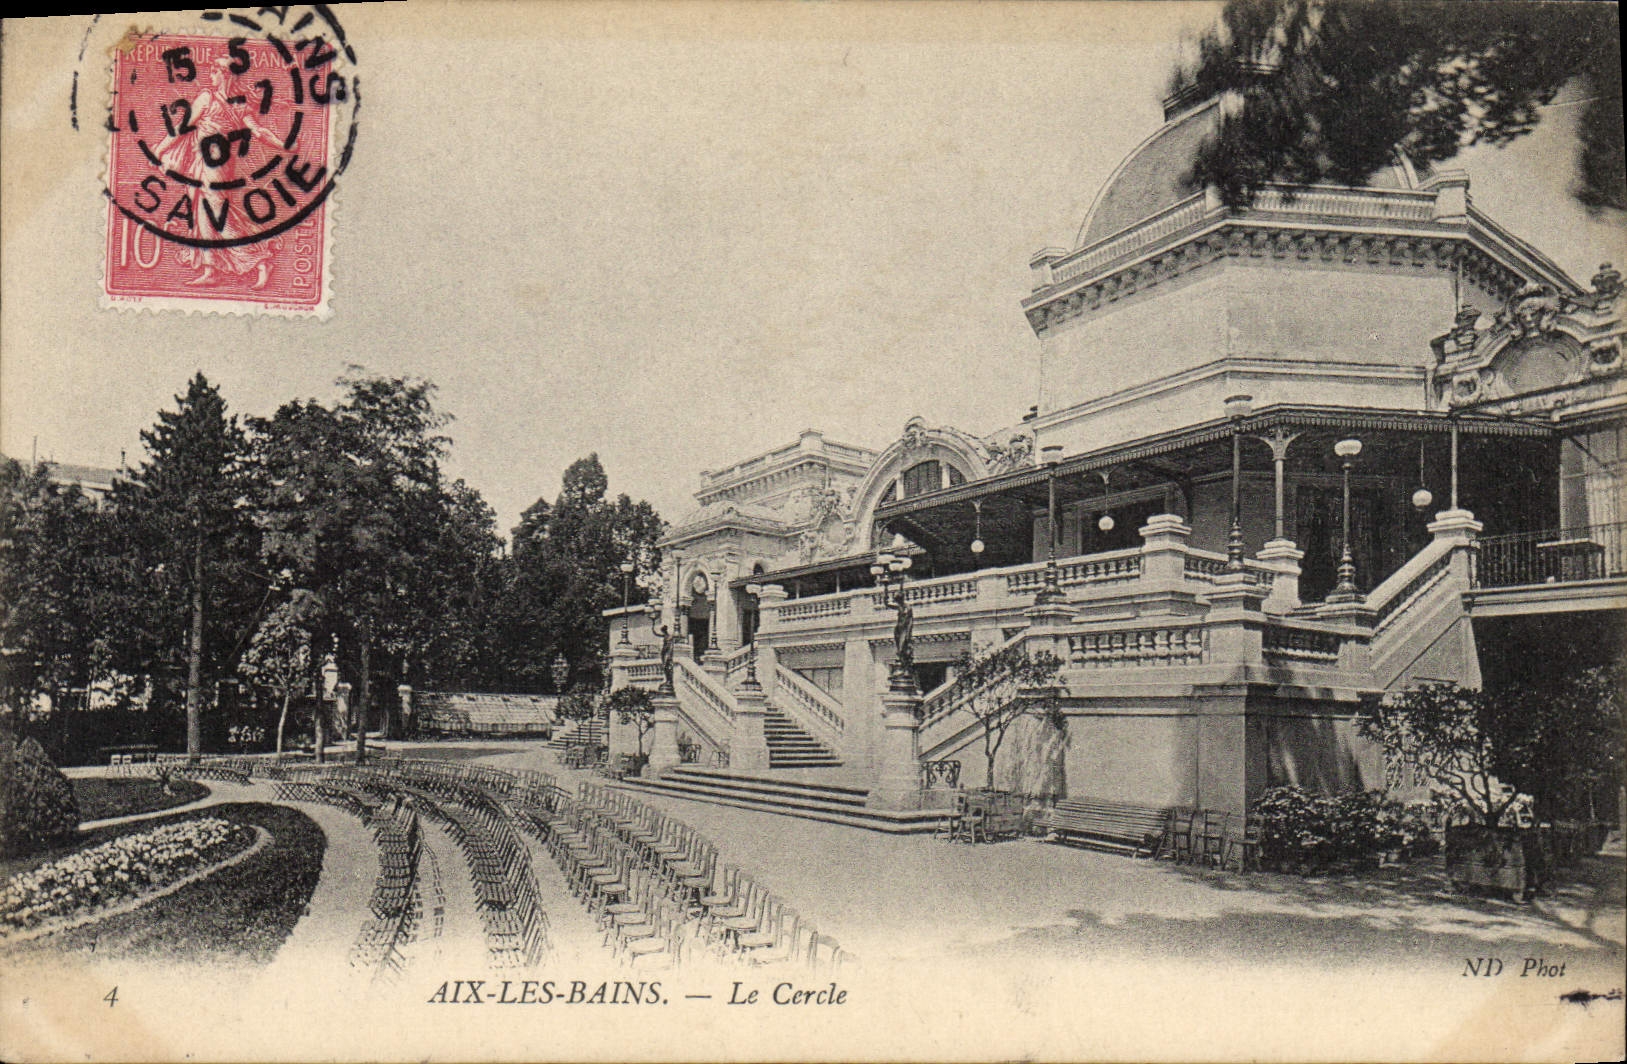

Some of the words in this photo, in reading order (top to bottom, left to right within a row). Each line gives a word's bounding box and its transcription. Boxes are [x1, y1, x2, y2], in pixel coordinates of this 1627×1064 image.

[160, 99, 197, 137] 12
[200, 128, 251, 168] 07
[134, 154, 327, 233] SAVOIE
